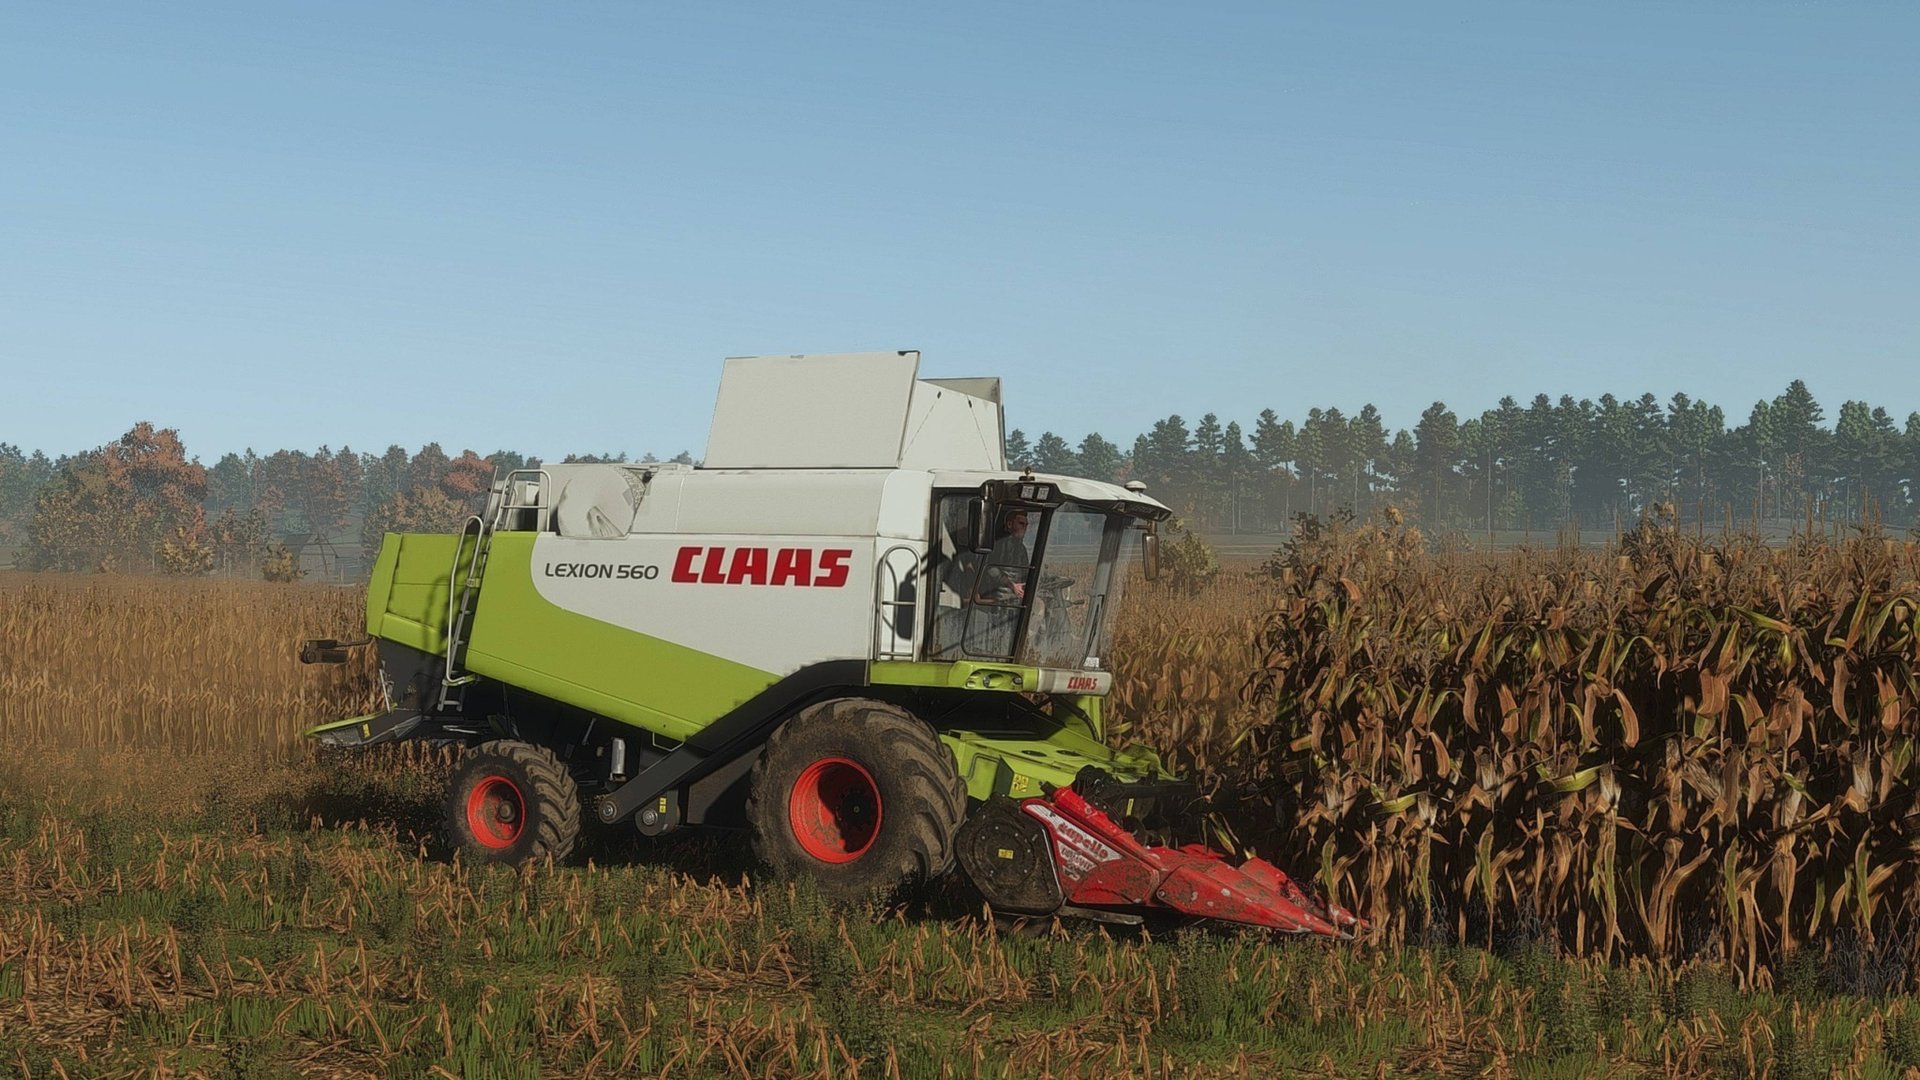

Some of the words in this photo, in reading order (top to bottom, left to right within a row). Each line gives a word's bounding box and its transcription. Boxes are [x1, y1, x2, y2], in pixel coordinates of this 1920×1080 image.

[545, 562, 613, 579] LEXION
[616, 564, 659, 580] 560
[671, 546, 852, 588] CLAAS
[1067, 676, 1098, 690] CLAAS
